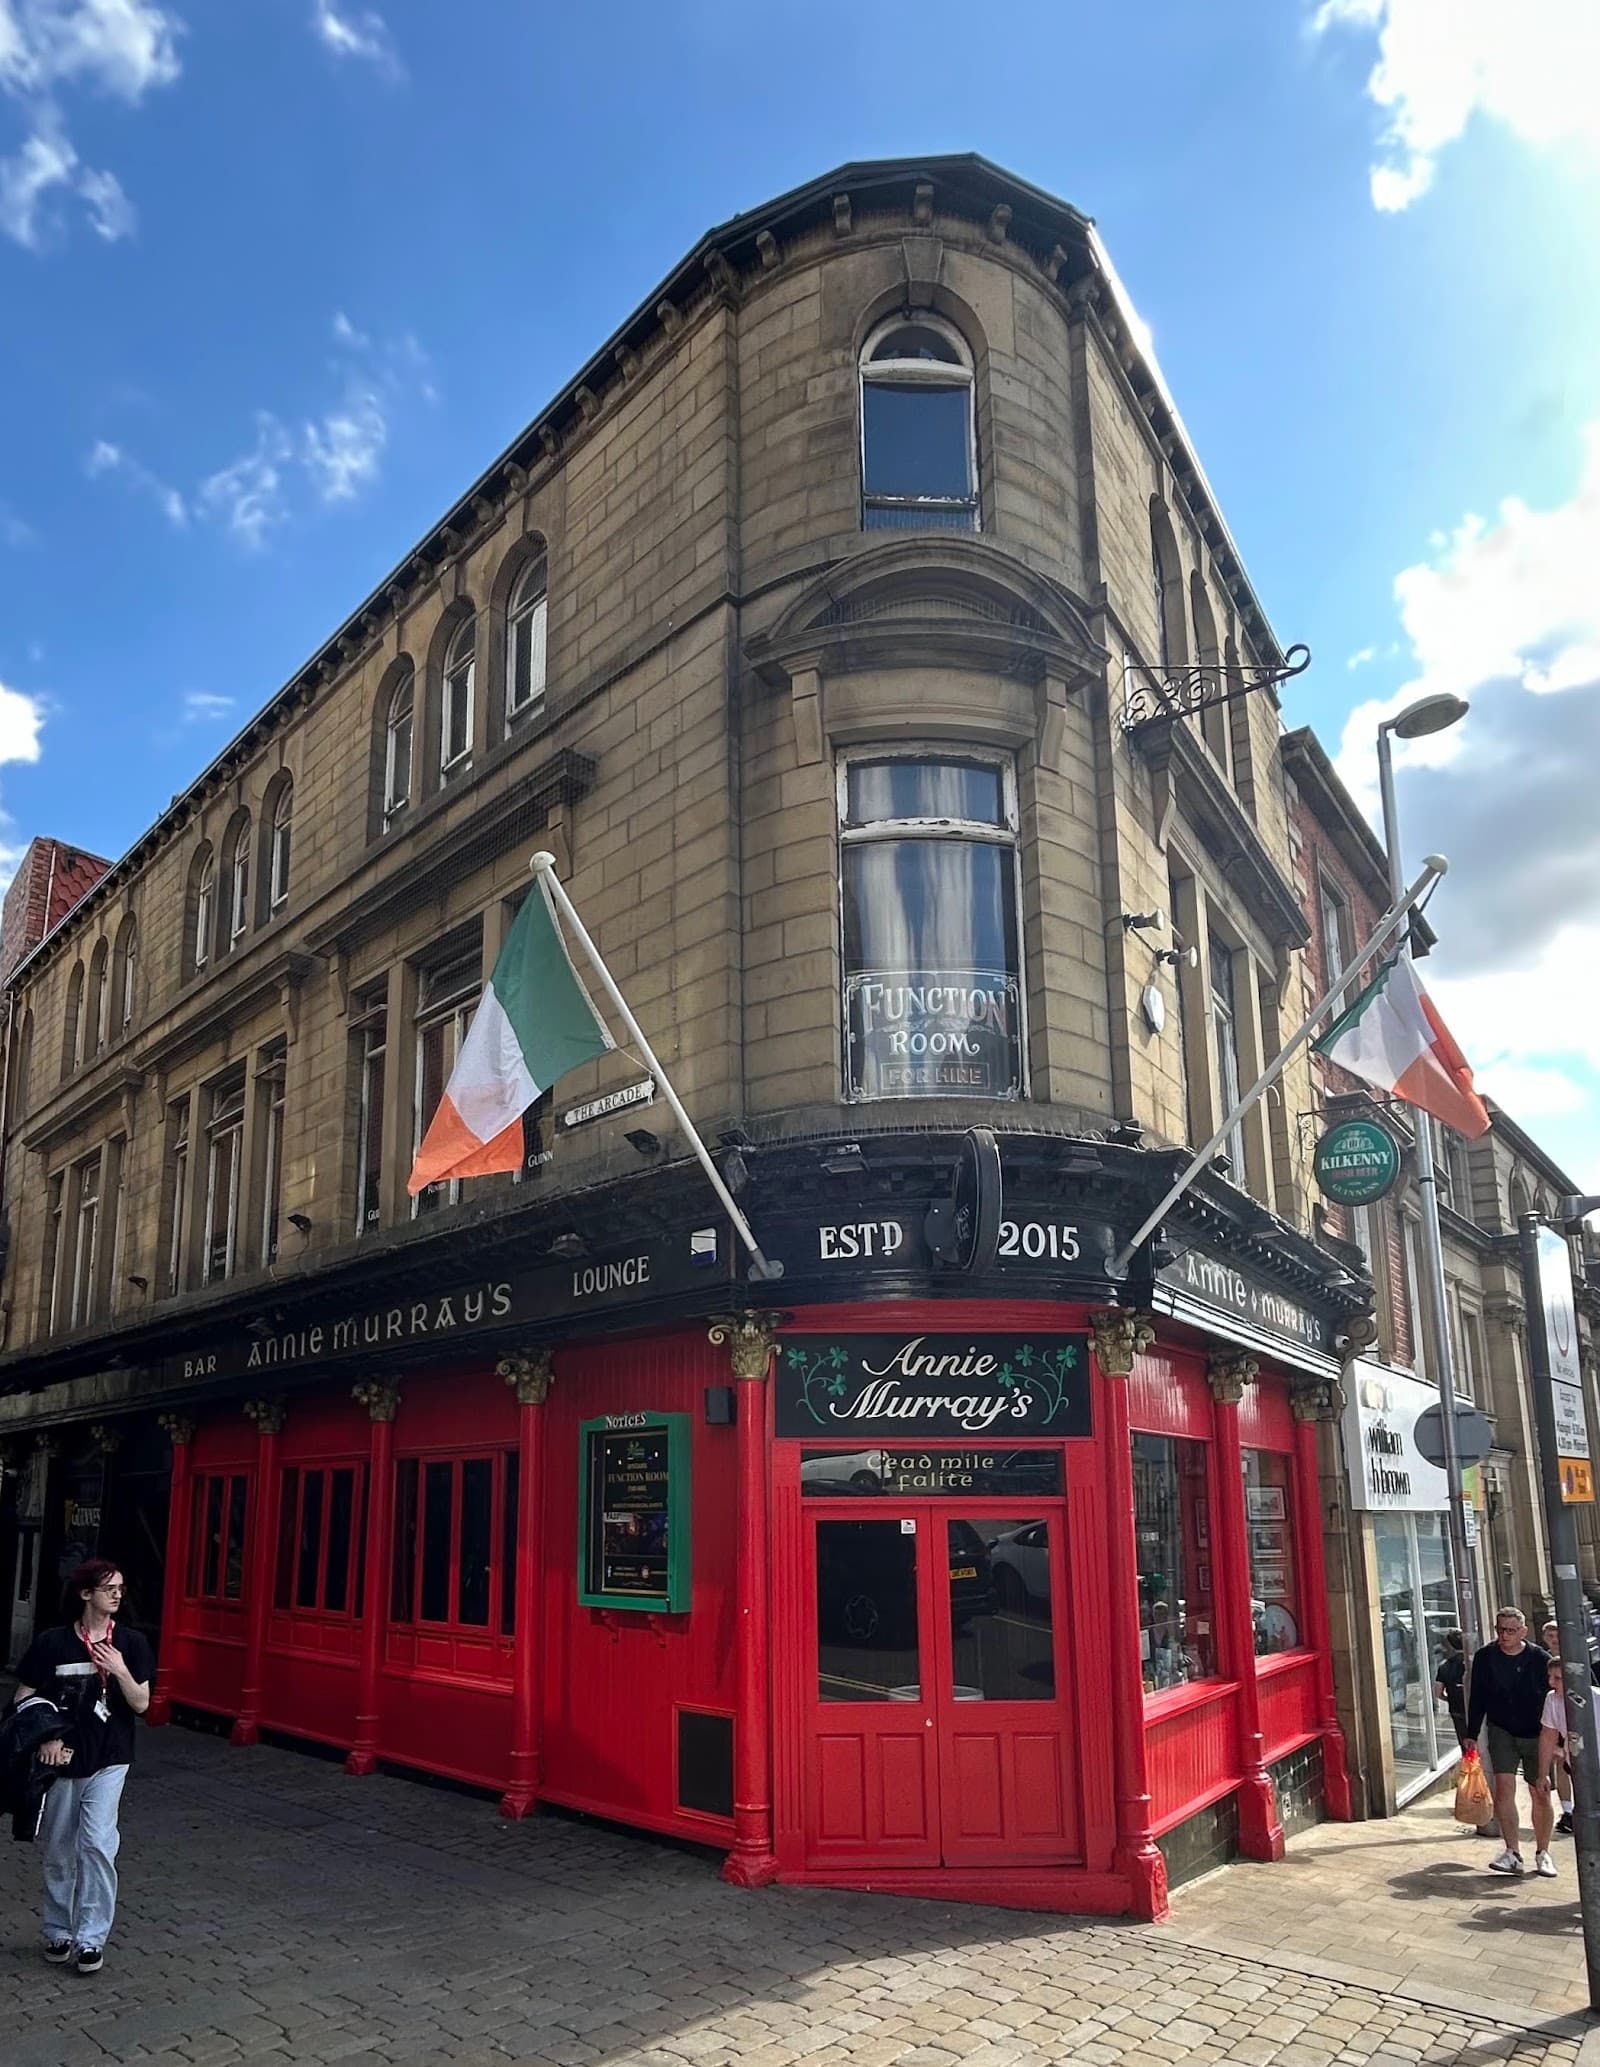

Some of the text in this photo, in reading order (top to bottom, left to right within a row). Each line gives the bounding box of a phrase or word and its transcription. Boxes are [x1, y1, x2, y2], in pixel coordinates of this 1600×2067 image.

[862, 983, 1008, 1038] FUNCTION
[889, 1031, 980, 1056] ROOM
[889, 1067, 982, 1085] FOR HIRE
[574, 1104, 594, 1121] THE
[1321, 1152, 1390, 1170] KILKENNY
[999, 1221, 1080, 1261] 2015
[573, 1256, 650, 1297] LOUNGE
[184, 1355, 217, 1378] BAR
[862, 1336, 998, 1377] Annie
[829, 1379, 1033, 1431] Murray's
[605, 1412, 646, 1429] NOTICES
[1369, 1420, 1403, 1456] william
[940, 1454, 994, 1470] mile
[1371, 1458, 1411, 1496] h brown
